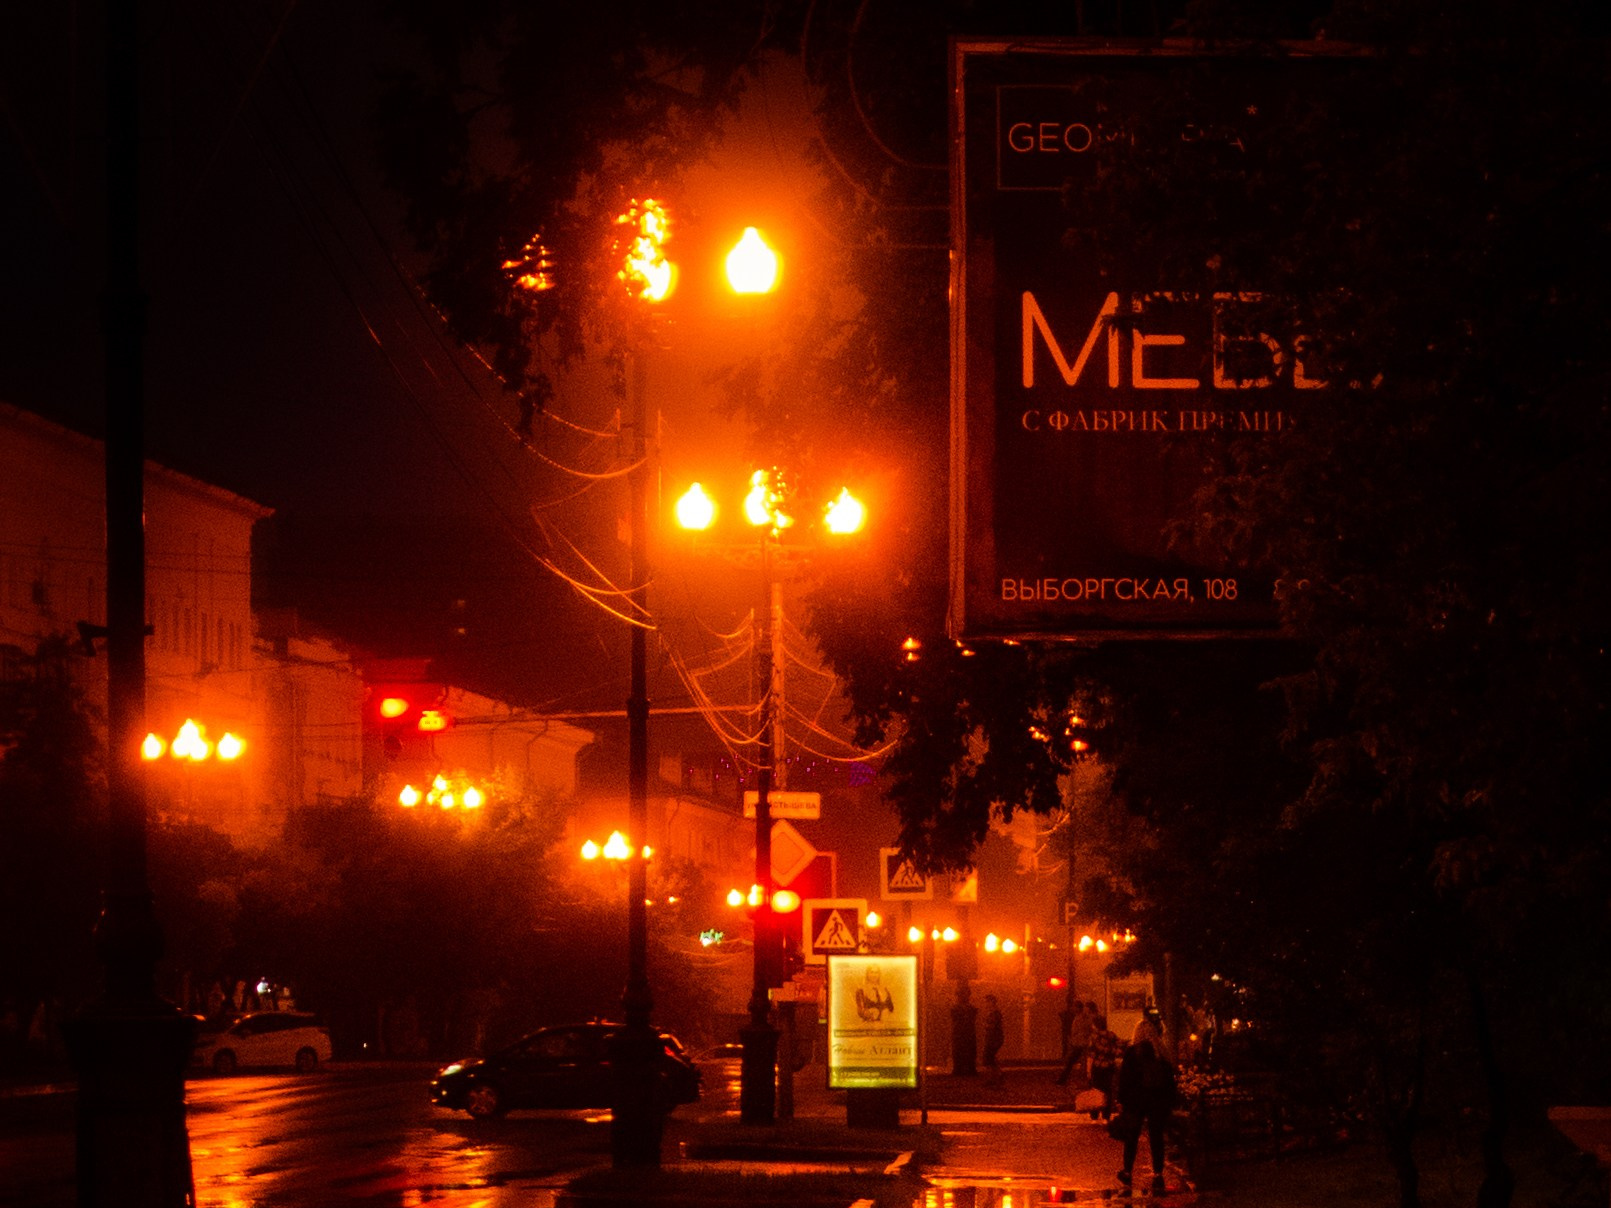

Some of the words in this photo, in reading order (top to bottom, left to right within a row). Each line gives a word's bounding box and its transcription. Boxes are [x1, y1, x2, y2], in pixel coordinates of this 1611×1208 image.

[1021, 410, 1041, 432] С
[1048, 409, 1168, 433] ФАБРИК
[1179, 410, 1297, 432] ПРЕМИ
[1001, 578, 1194, 604] ВЫБОРГСКАЯ,
[1203, 578, 1239, 601] 108
